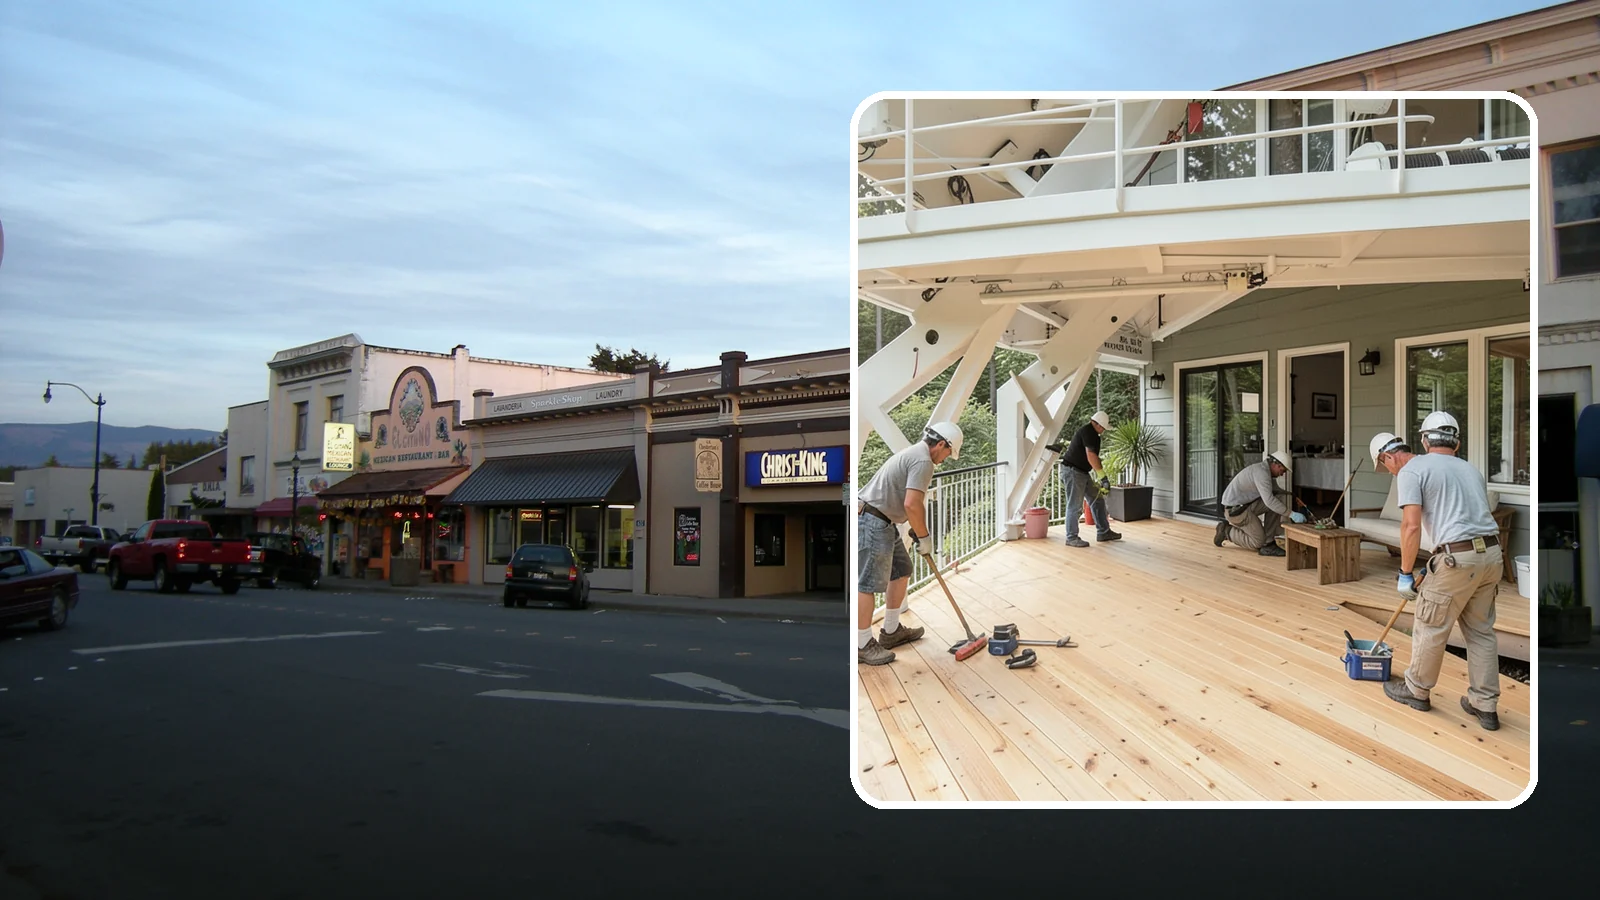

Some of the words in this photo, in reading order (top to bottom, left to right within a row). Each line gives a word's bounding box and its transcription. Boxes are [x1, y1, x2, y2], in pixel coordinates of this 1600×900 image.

[595, 388, 624, 401] LAUNDRY
[493, 402, 523, 414] LAVANDERIA
[530, 397, 562, 409] Sparkle
[561, 394, 582, 407] Shop
[373, 455, 396, 464] MEXICAN
[397, 451, 434, 463] RESTAURANT
[438, 450, 451, 460] BAR
[761, 452, 797, 478] CHRIST
[799, 450, 828, 477] KING
[710, 481, 722, 489] House
